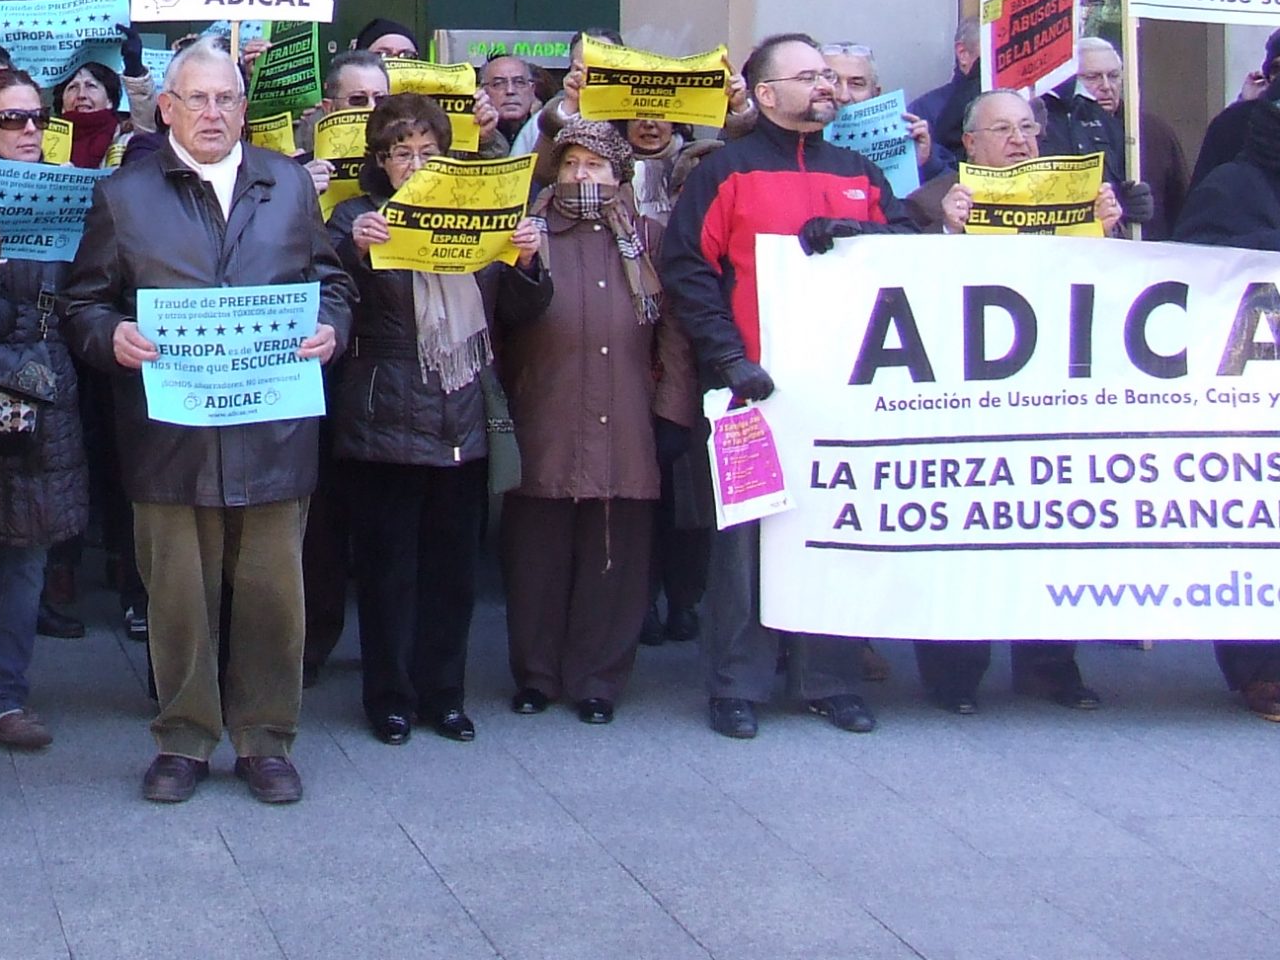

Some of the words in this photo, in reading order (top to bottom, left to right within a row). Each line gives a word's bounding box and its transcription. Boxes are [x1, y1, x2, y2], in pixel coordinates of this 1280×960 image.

[1011, 0, 1058, 36] ABUSOS
[5, 29, 54, 43] EUROPA
[998, 49, 1012, 70] DE
[1014, 41, 1031, 59] LA
[1034, 17, 1070, 50] BANCA
[589, 73, 609, 83] EL
[612, 74, 722, 87] "CORRALITO"
[633, 99, 670, 108] ADICAE
[22, 170, 36, 180] de
[386, 208, 406, 225] EL
[968, 210, 990, 223] EL
[994, 207, 1092, 226] "CORRALITO"
[0, 235, 53, 247] ADICAE
[433, 233, 478, 244] ESPAÑOL
[432, 248, 472, 258] ADICAE
[154, 298, 197, 309] fraude
[200, 296, 216, 308] de
[219, 293, 308, 307] PREFERENTES
[188, 310, 231, 322] productos
[267, 307, 277, 315] de
[160, 343, 226, 357] EUROPA
[240, 346, 252, 355] de
[151, 359, 170, 370] nos
[174, 362, 204, 373] tiene
[206, 363, 229, 375] que
[204, 392, 262, 409] ADICAE
[875, 391, 972, 413] Asociación
[979, 391, 1001, 408] de
[1008, 388, 1088, 407] Usuarios
[1094, 387, 1118, 405] de
[1125, 387, 1198, 407] Bancos,
[1206, 387, 1260, 408] Cajas
[1268, 392, 1280, 407] y
[810, 460, 856, 490] LA
[874, 457, 1015, 490] FUERZA
[1031, 454, 1072, 485] DE
[1089, 453, 1159, 483] LOS
[833, 503, 862, 531] A
[879, 501, 949, 532] LOS
[963, 500, 1119, 530] ABUSOS
[1135, 499, 1280, 529] BANCA
